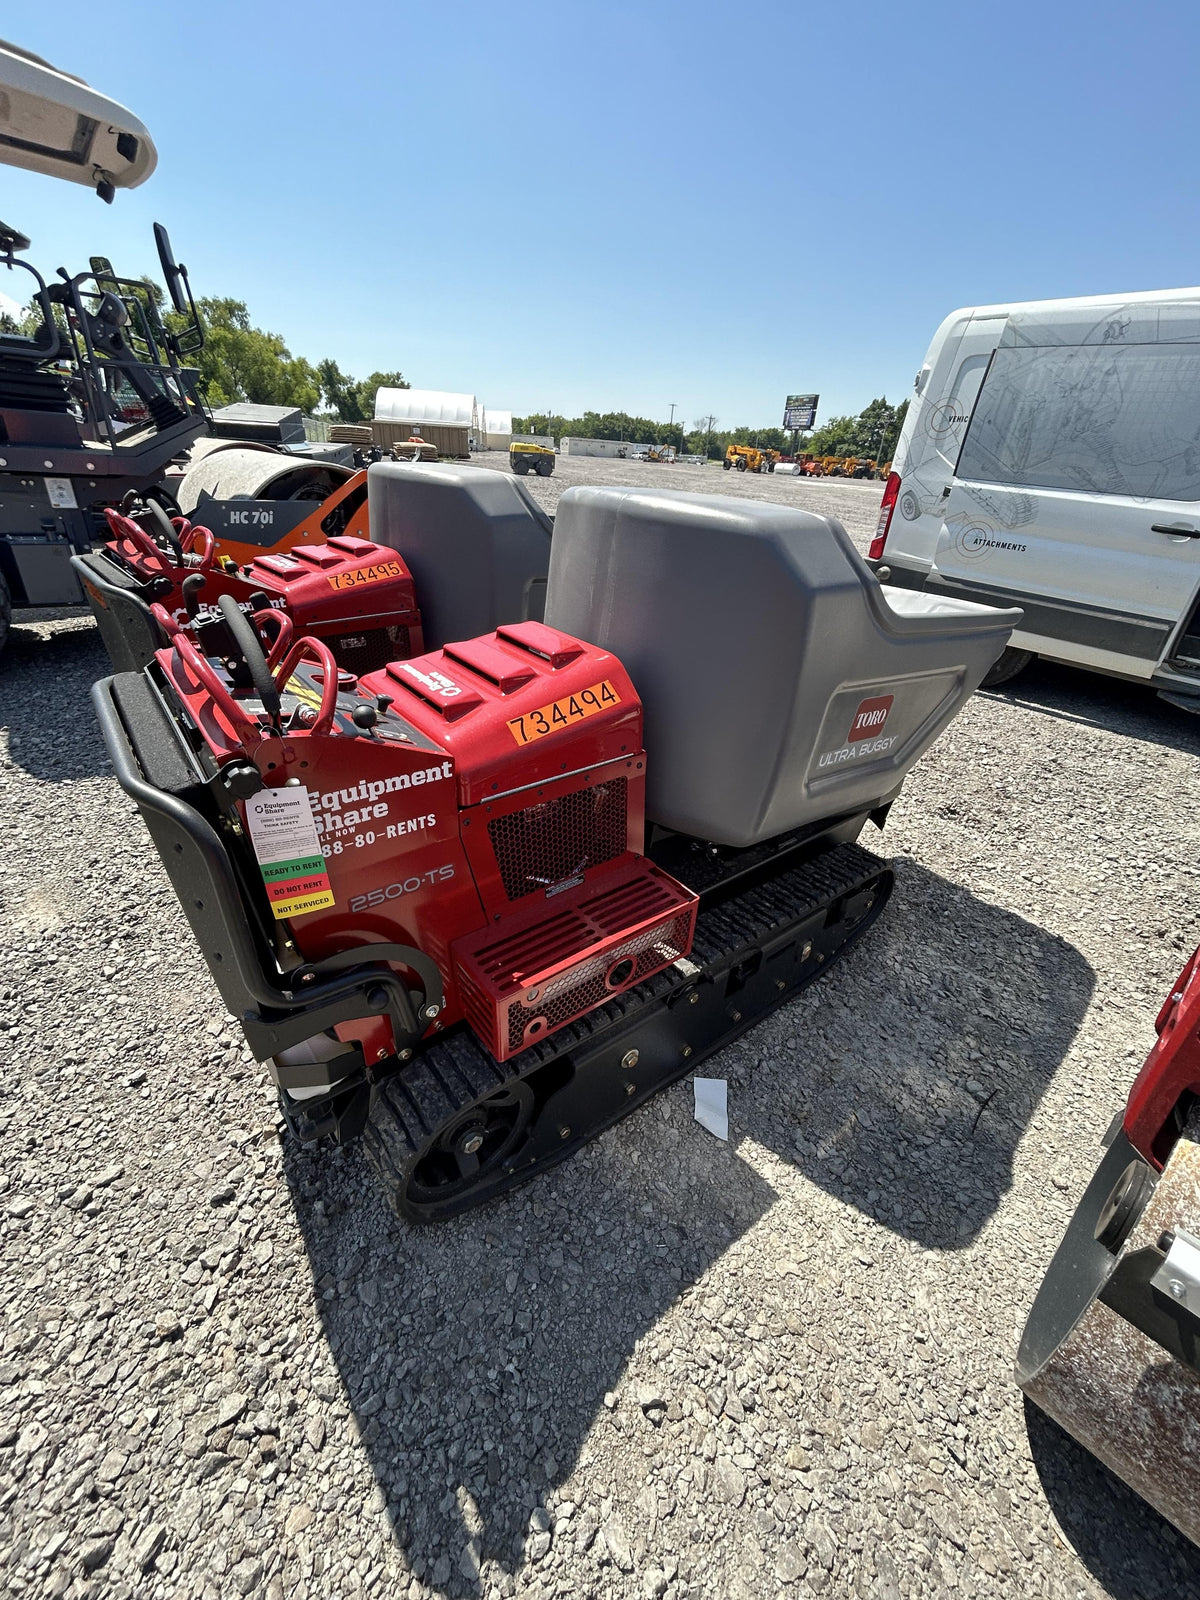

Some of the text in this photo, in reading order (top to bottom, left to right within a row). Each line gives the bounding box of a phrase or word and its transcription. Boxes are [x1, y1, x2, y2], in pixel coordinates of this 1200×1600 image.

[230, 511, 274, 524] HC 70i
[973, 538, 1027, 552] ATTACHMENTS
[330, 562, 401, 589] 734495
[510, 682, 616, 742] 734494
[855, 708, 887, 729] TORO
[818, 737, 897, 767] ULTRA BUGGY
[307, 761, 453, 812] Equipment
[335, 826, 357, 838] NOW
[264, 861, 322, 877] READY TO RENT
[286, 885, 302, 893] NOT
[303, 880, 322, 888] RENT
[277, 897, 329, 914] NOT SERVICED
